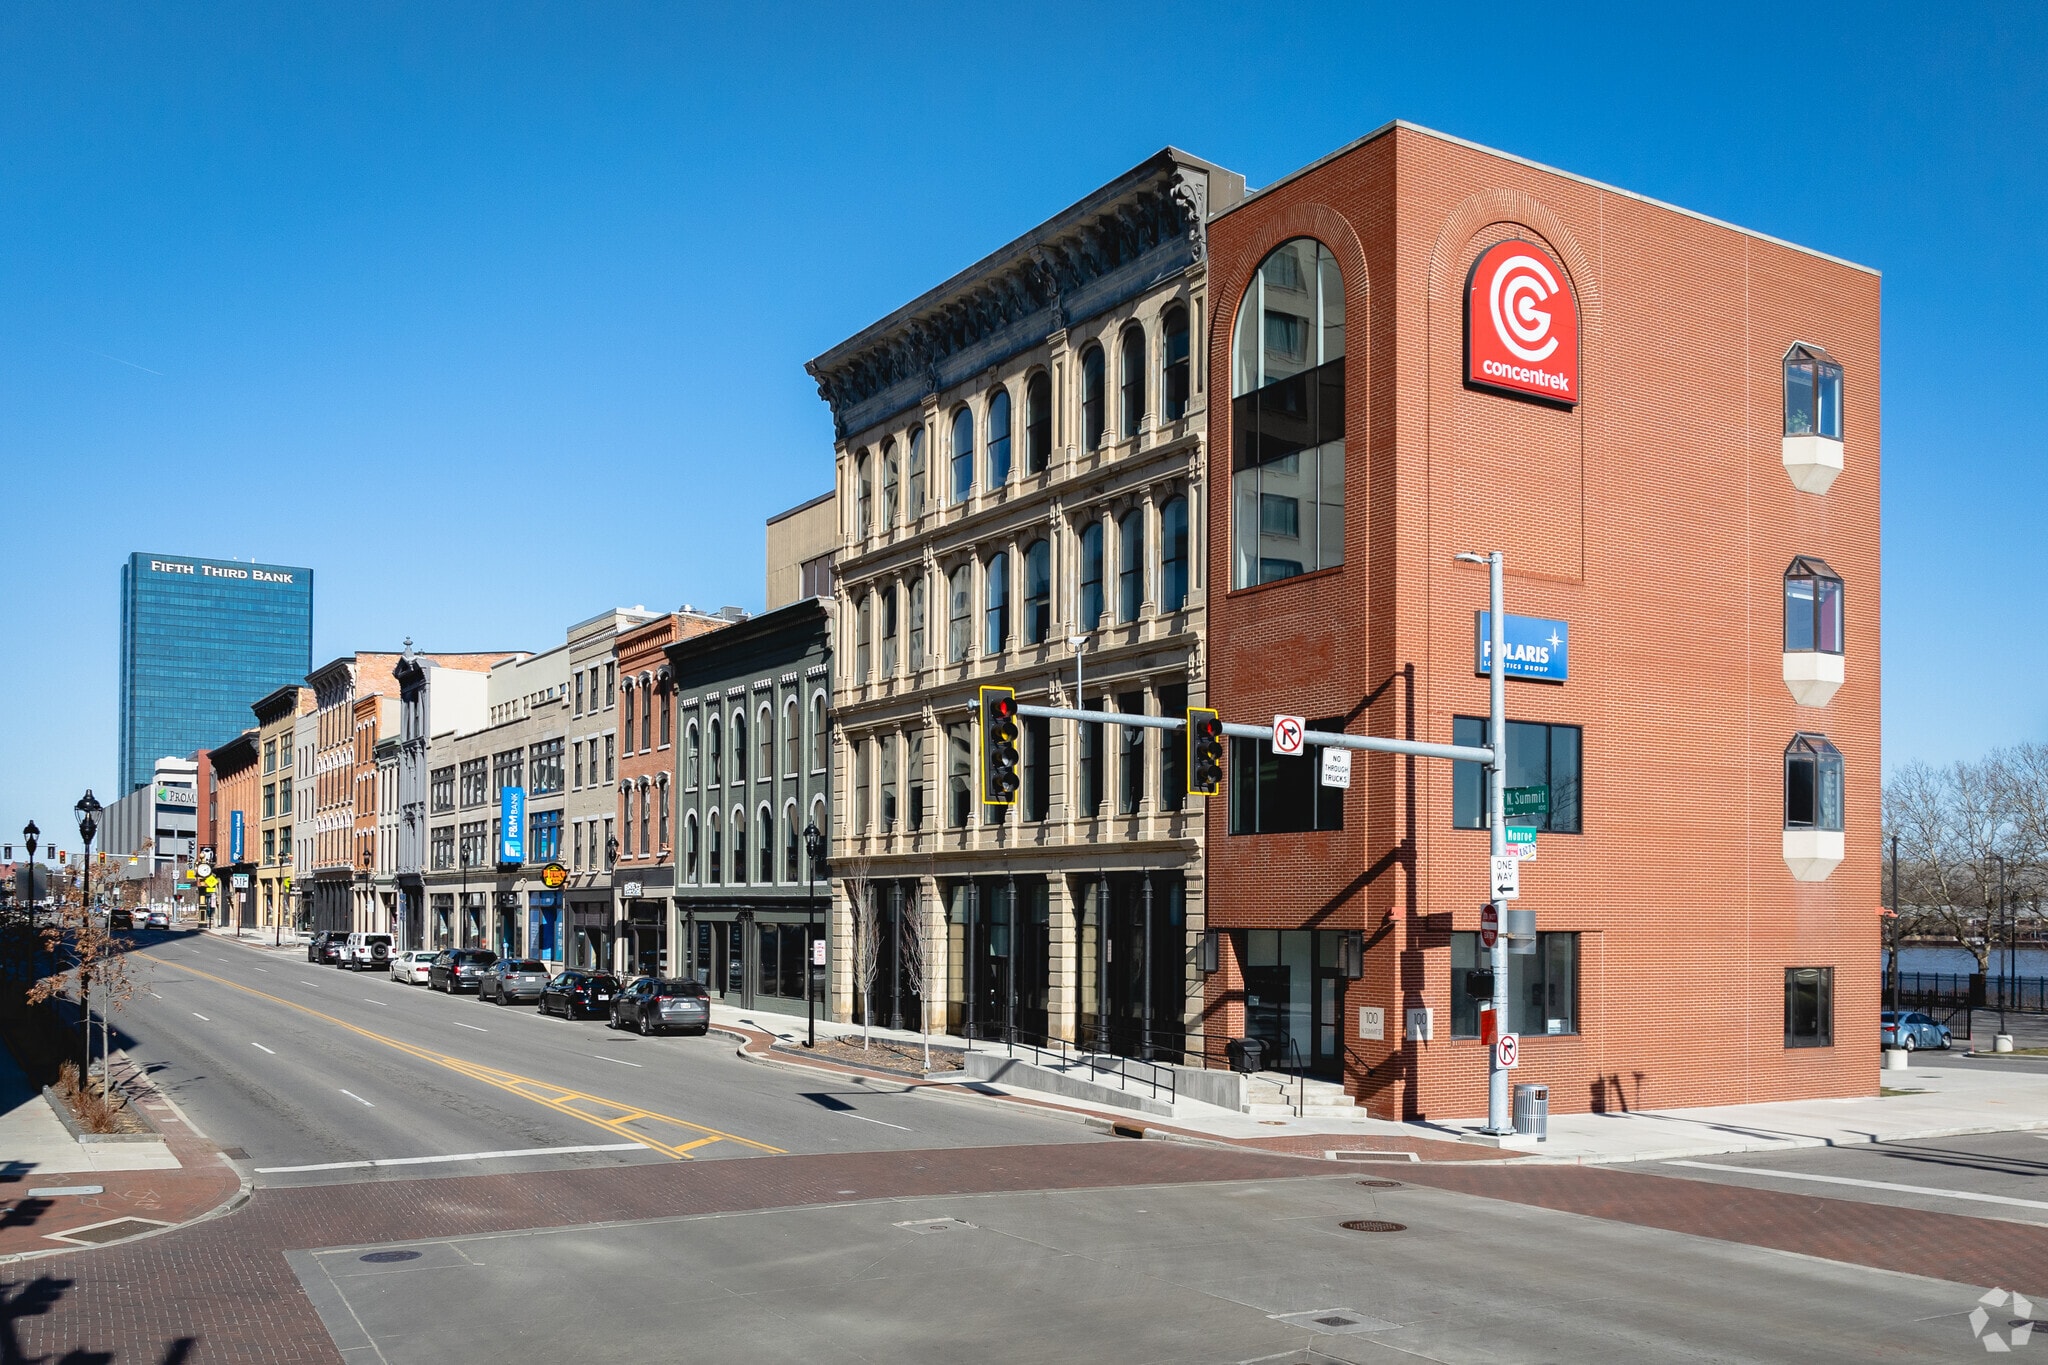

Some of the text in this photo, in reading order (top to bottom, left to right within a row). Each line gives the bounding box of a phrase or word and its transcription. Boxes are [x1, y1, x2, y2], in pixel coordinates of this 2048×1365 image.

[1482, 359, 1570, 391] concentrek
[150, 560, 294, 584] FIFTH THIRD BANK
[1483, 640, 1549, 664] PLARIS
[1483, 660, 1548, 673] LOSTICS GROUP
[1332, 755, 1342, 763] NO
[1325, 763, 1349, 773] THROUGH
[1325, 773, 1347, 783] TRUCKS
[1514, 790, 1545, 805] Summit
[508, 792, 519, 838] F&M BANK
[1507, 829, 1533, 842] Monroe
[1496, 860, 1513, 870] ONE
[1497, 872, 1513, 881] WAY
[1365, 1012, 1379, 1025] 100
[1413, 1012, 1428, 1025] 100
